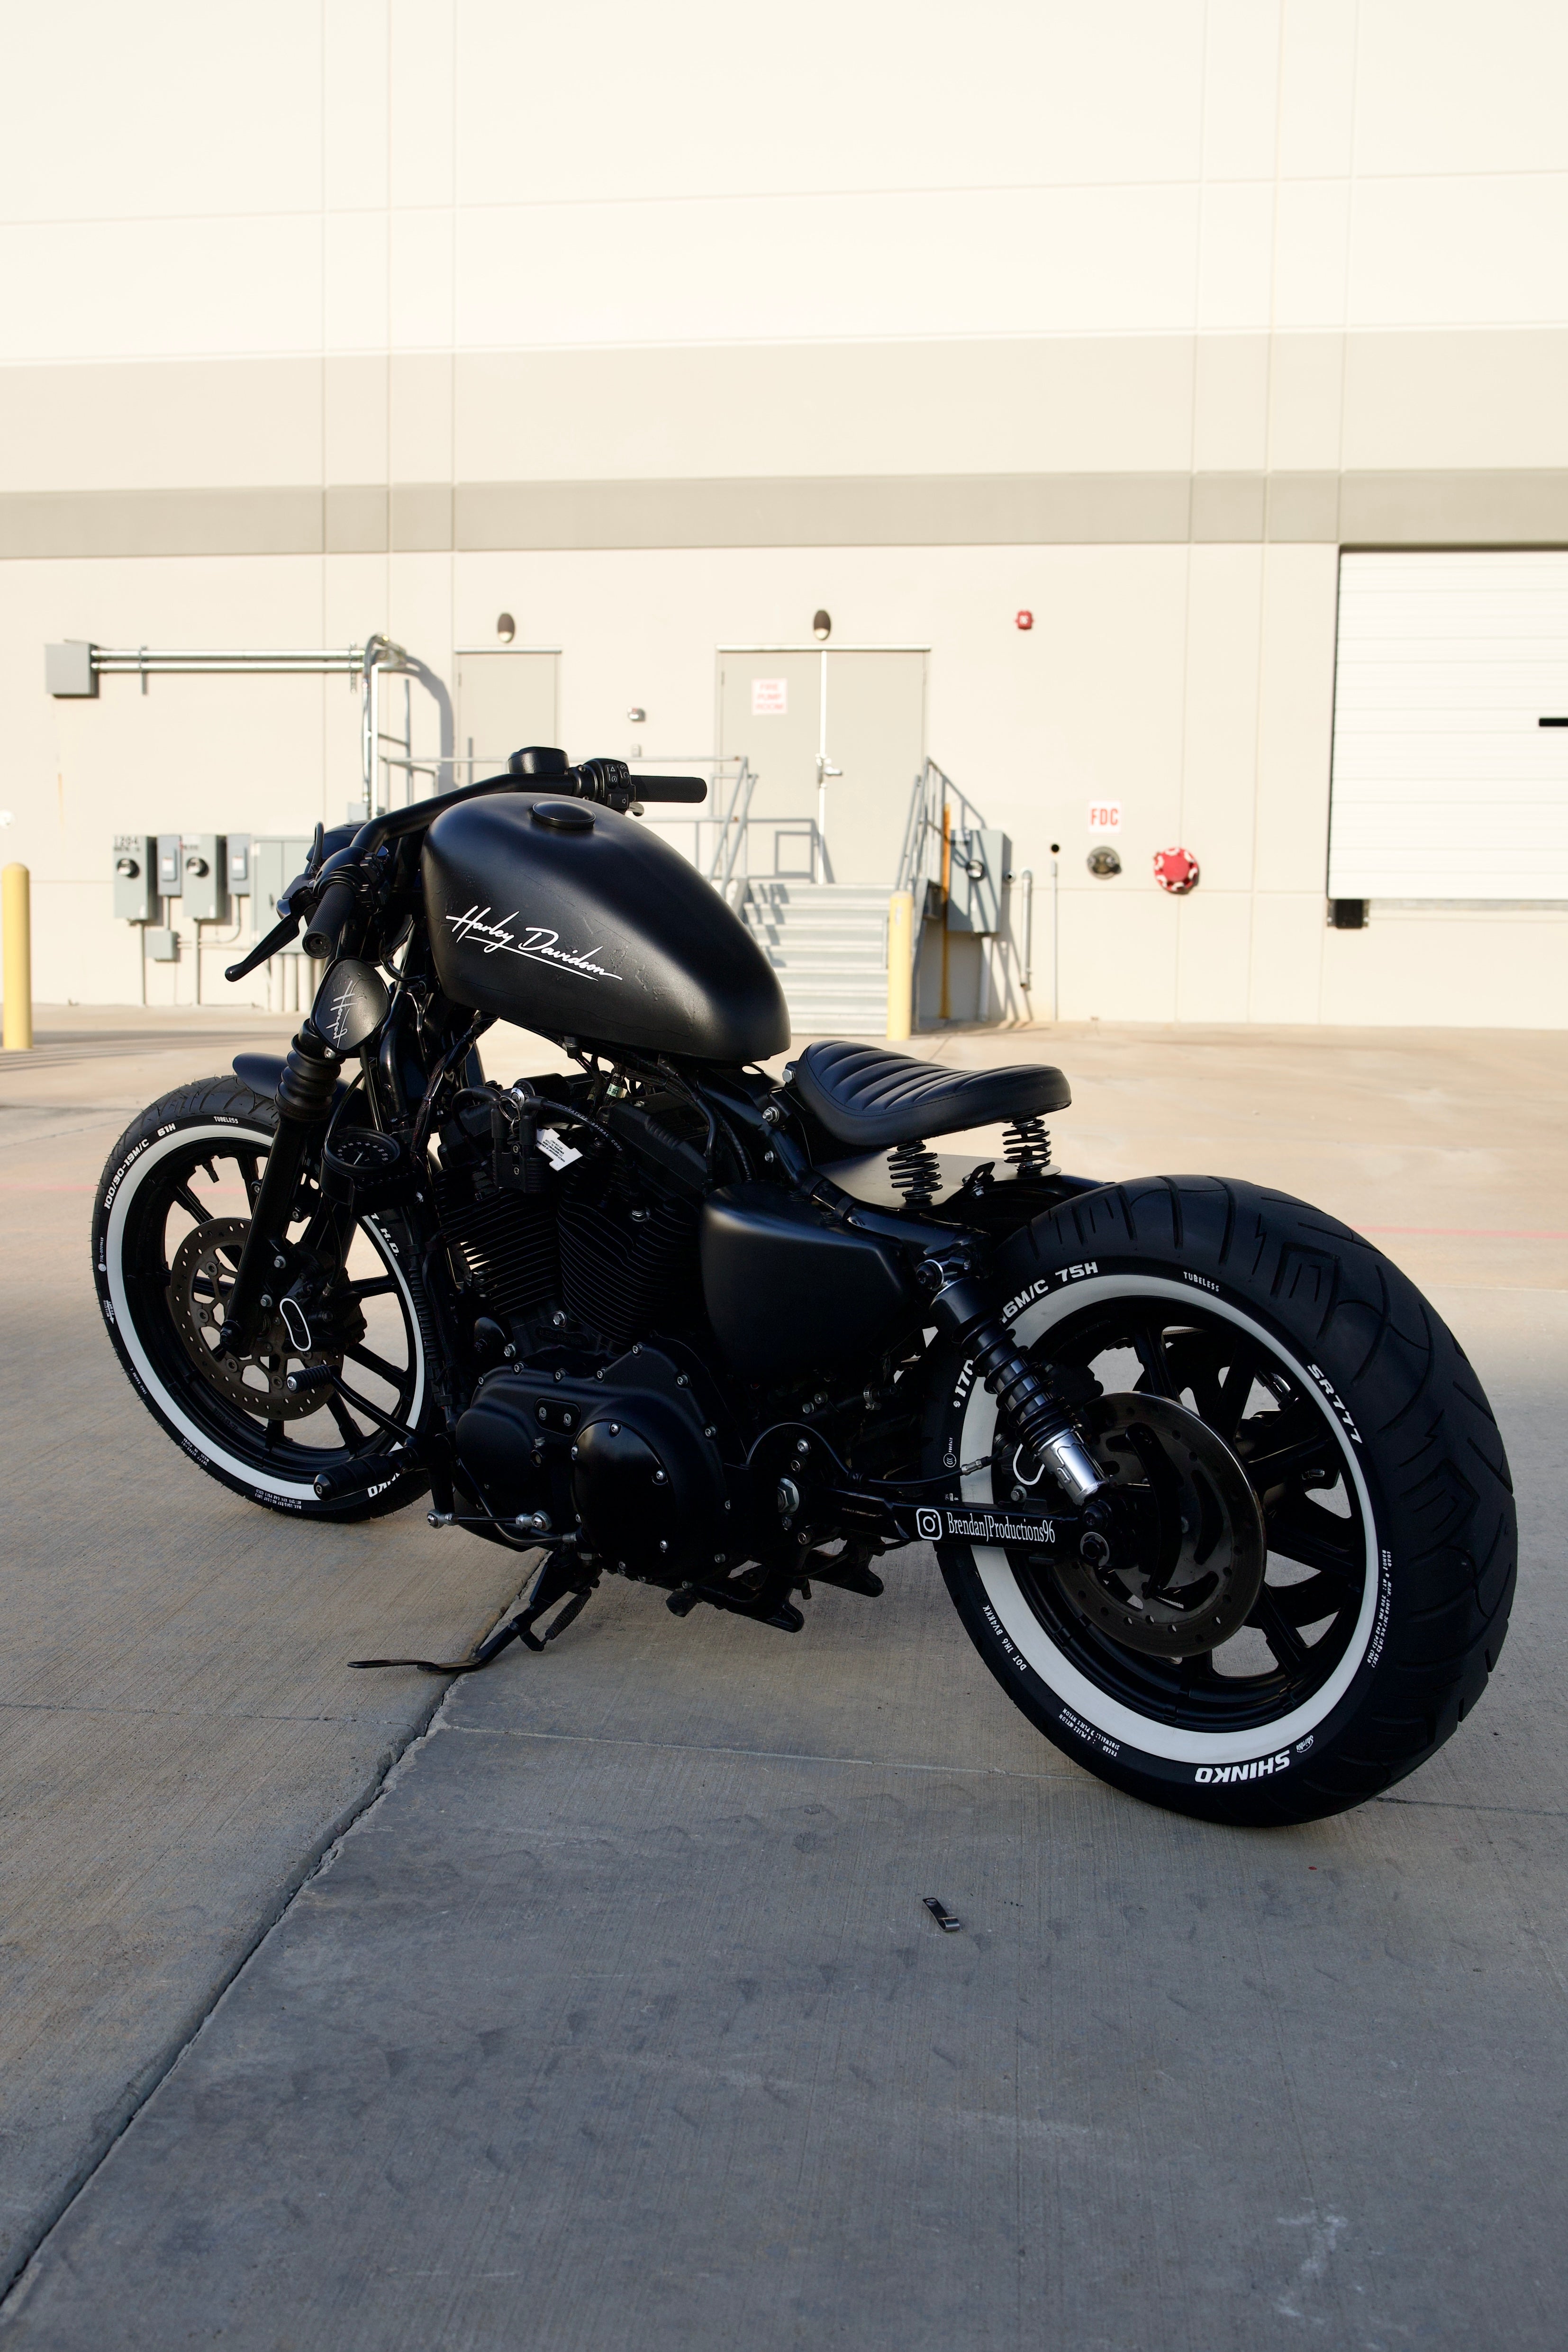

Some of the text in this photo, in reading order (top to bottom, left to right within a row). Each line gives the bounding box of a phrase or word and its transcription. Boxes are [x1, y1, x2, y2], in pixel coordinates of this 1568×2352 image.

[1091, 808, 1118, 826] FDC
[445, 905, 623, 981] Harley Davidson
[214, 1116, 238, 1124] TUBELESS
[104, 1123, 176, 1209] 100/90-19M/C 61H
[380, 1228, 399, 1256] H.D.
[1055, 1261, 1098, 1282] 75H
[1183, 1271, 1220, 1292] TUBELESS
[133, 1373, 141, 1384] RANGE
[1307, 1363, 1363, 1444] SR777
[947, 1512, 1055, 1544] BrendanJProductions96
[983, 1605, 1003, 1635] BV4KKK
[1013, 1655, 1027, 1671] DOT
[1059, 1714, 1074, 1728] NYLON
[1062, 1708, 1077, 1722] NYLON
[1074, 1726, 1087, 1738] PLIES
[1077, 1720, 1090, 1732] PLIES
[1096, 1733, 1120, 1750] SIDEWALL:
[1103, 1746, 1117, 1757] TREAD
[1195, 1749, 1291, 1783] SHINKO
